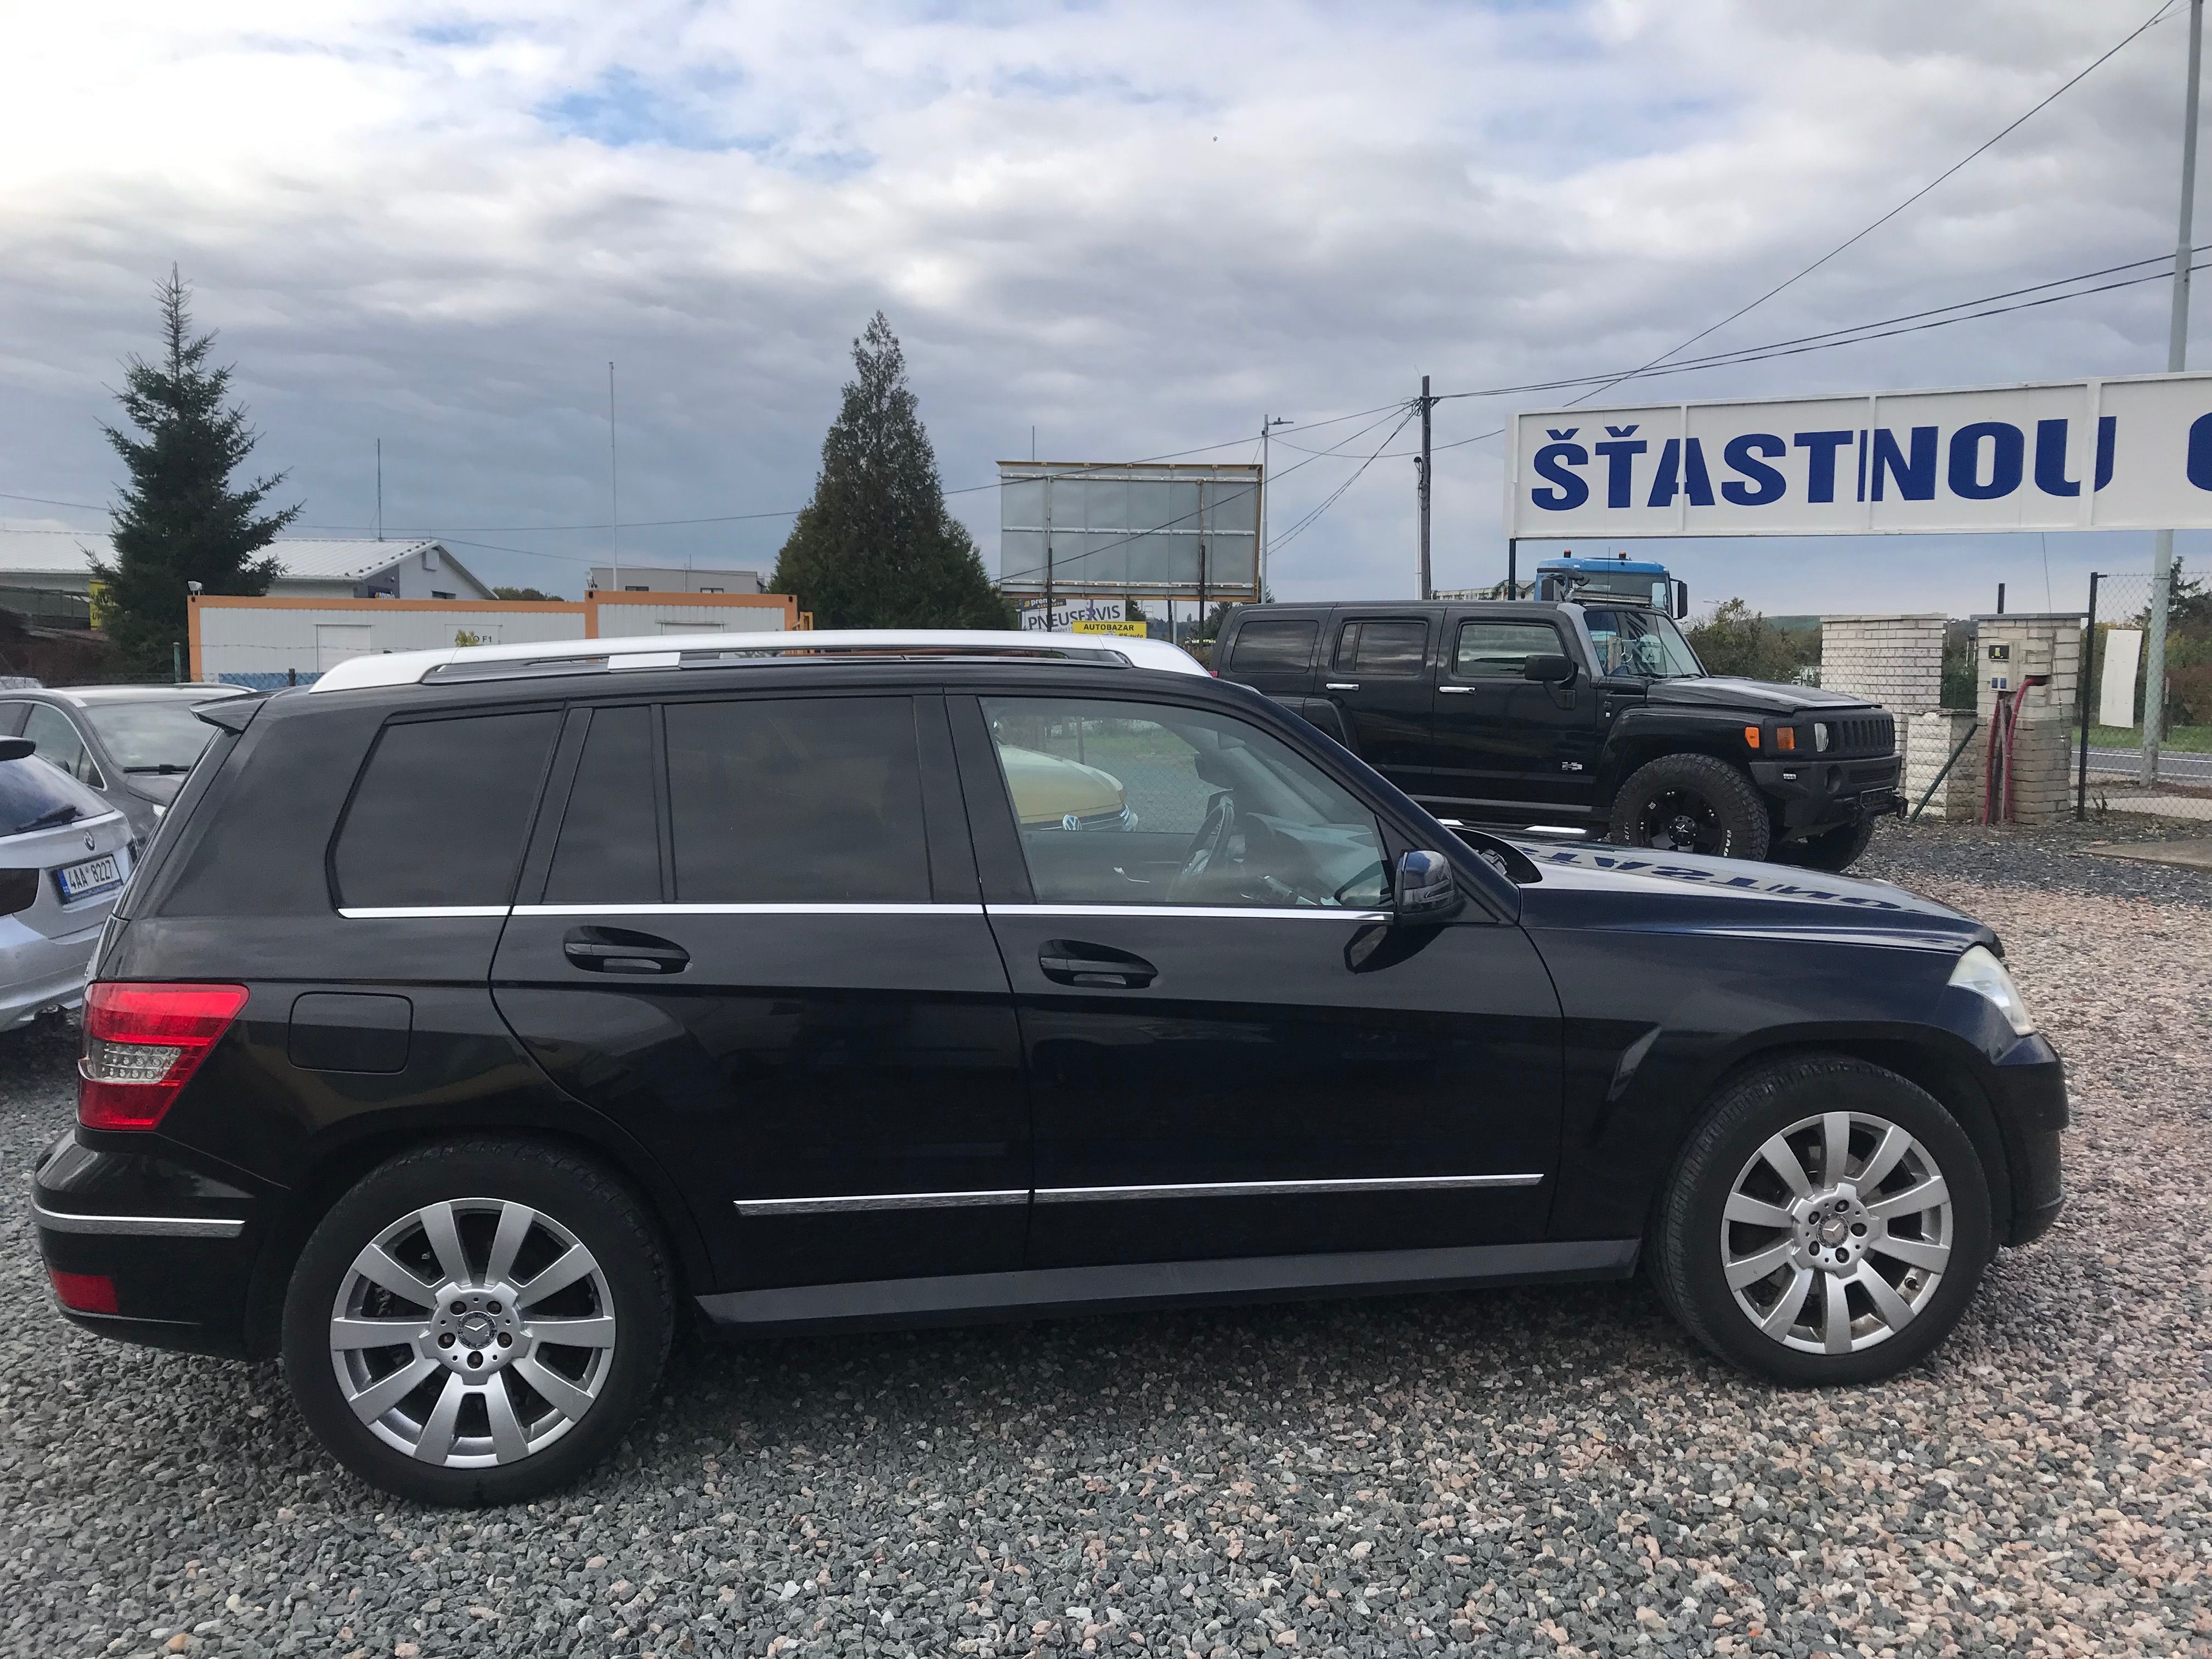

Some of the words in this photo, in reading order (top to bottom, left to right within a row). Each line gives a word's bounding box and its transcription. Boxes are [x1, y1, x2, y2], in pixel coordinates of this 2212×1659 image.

[1531, 416, 2117, 511] ŠŤASTNOU
[1028, 605, 1120, 630] PNEUSERVIS
[68, 867, 88, 889] 4AA
[91, 859, 112, 883] 8227
